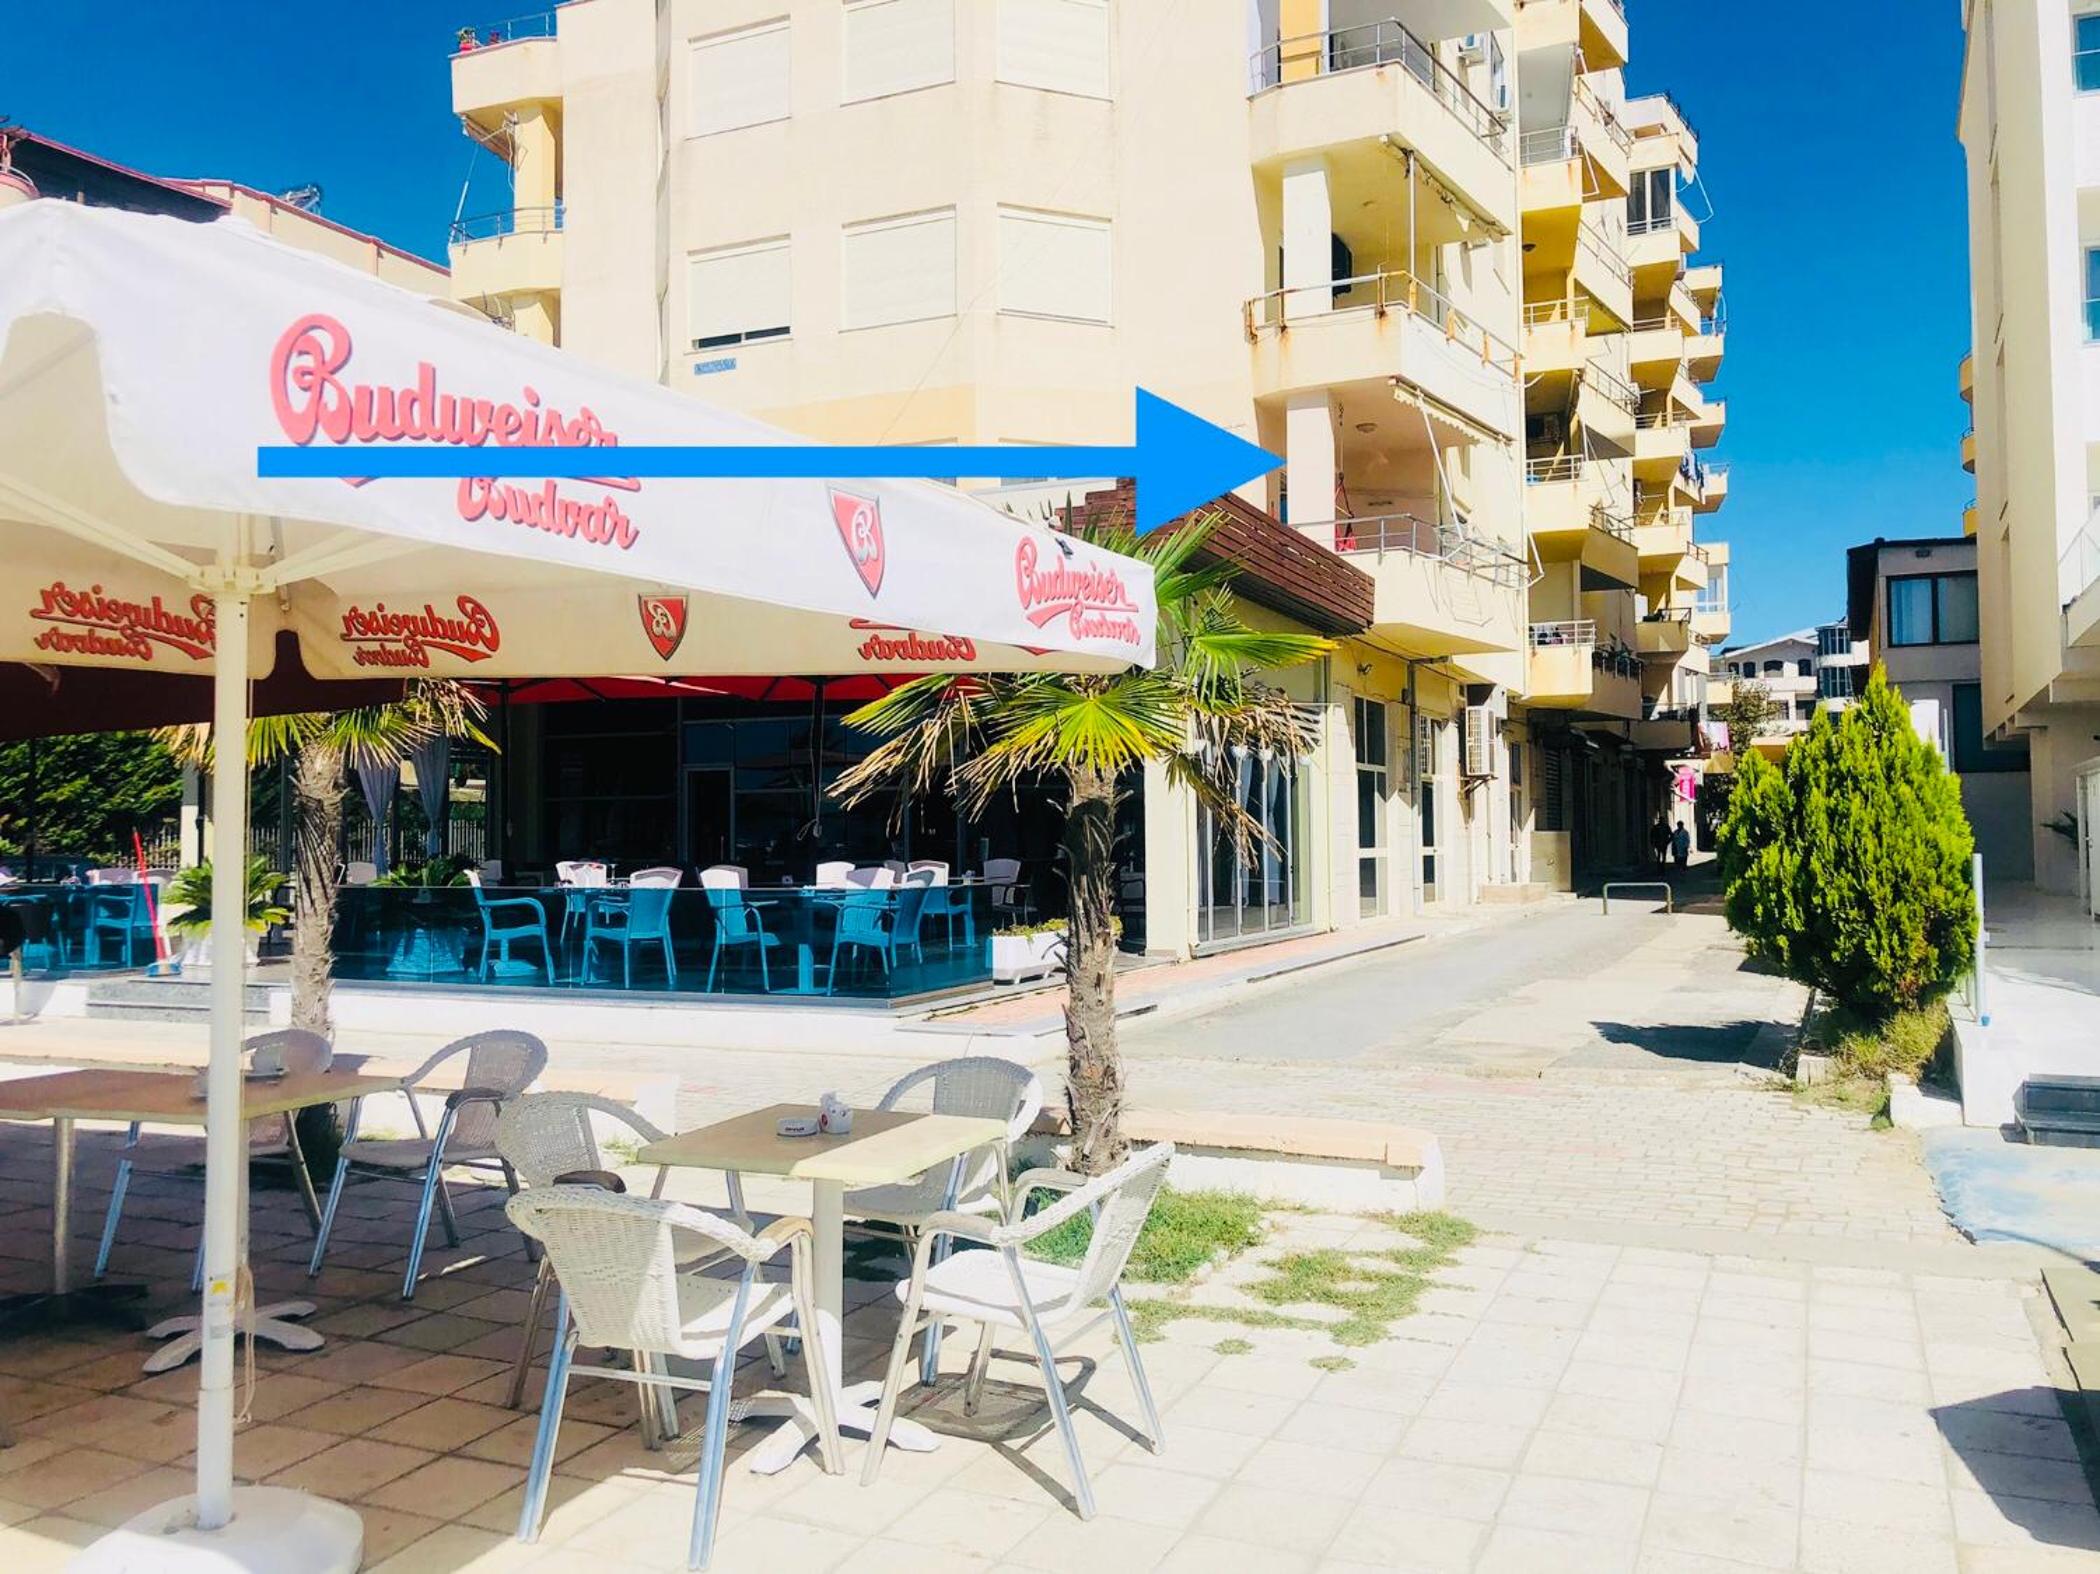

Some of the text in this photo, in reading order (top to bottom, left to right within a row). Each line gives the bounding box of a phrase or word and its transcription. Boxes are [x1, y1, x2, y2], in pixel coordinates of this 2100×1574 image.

[269, 313, 619, 449] Budweiser
[457, 475, 640, 549] Budvar
[1014, 536, 1139, 613] Budweiser
[1069, 602, 1141, 646] Budvar
